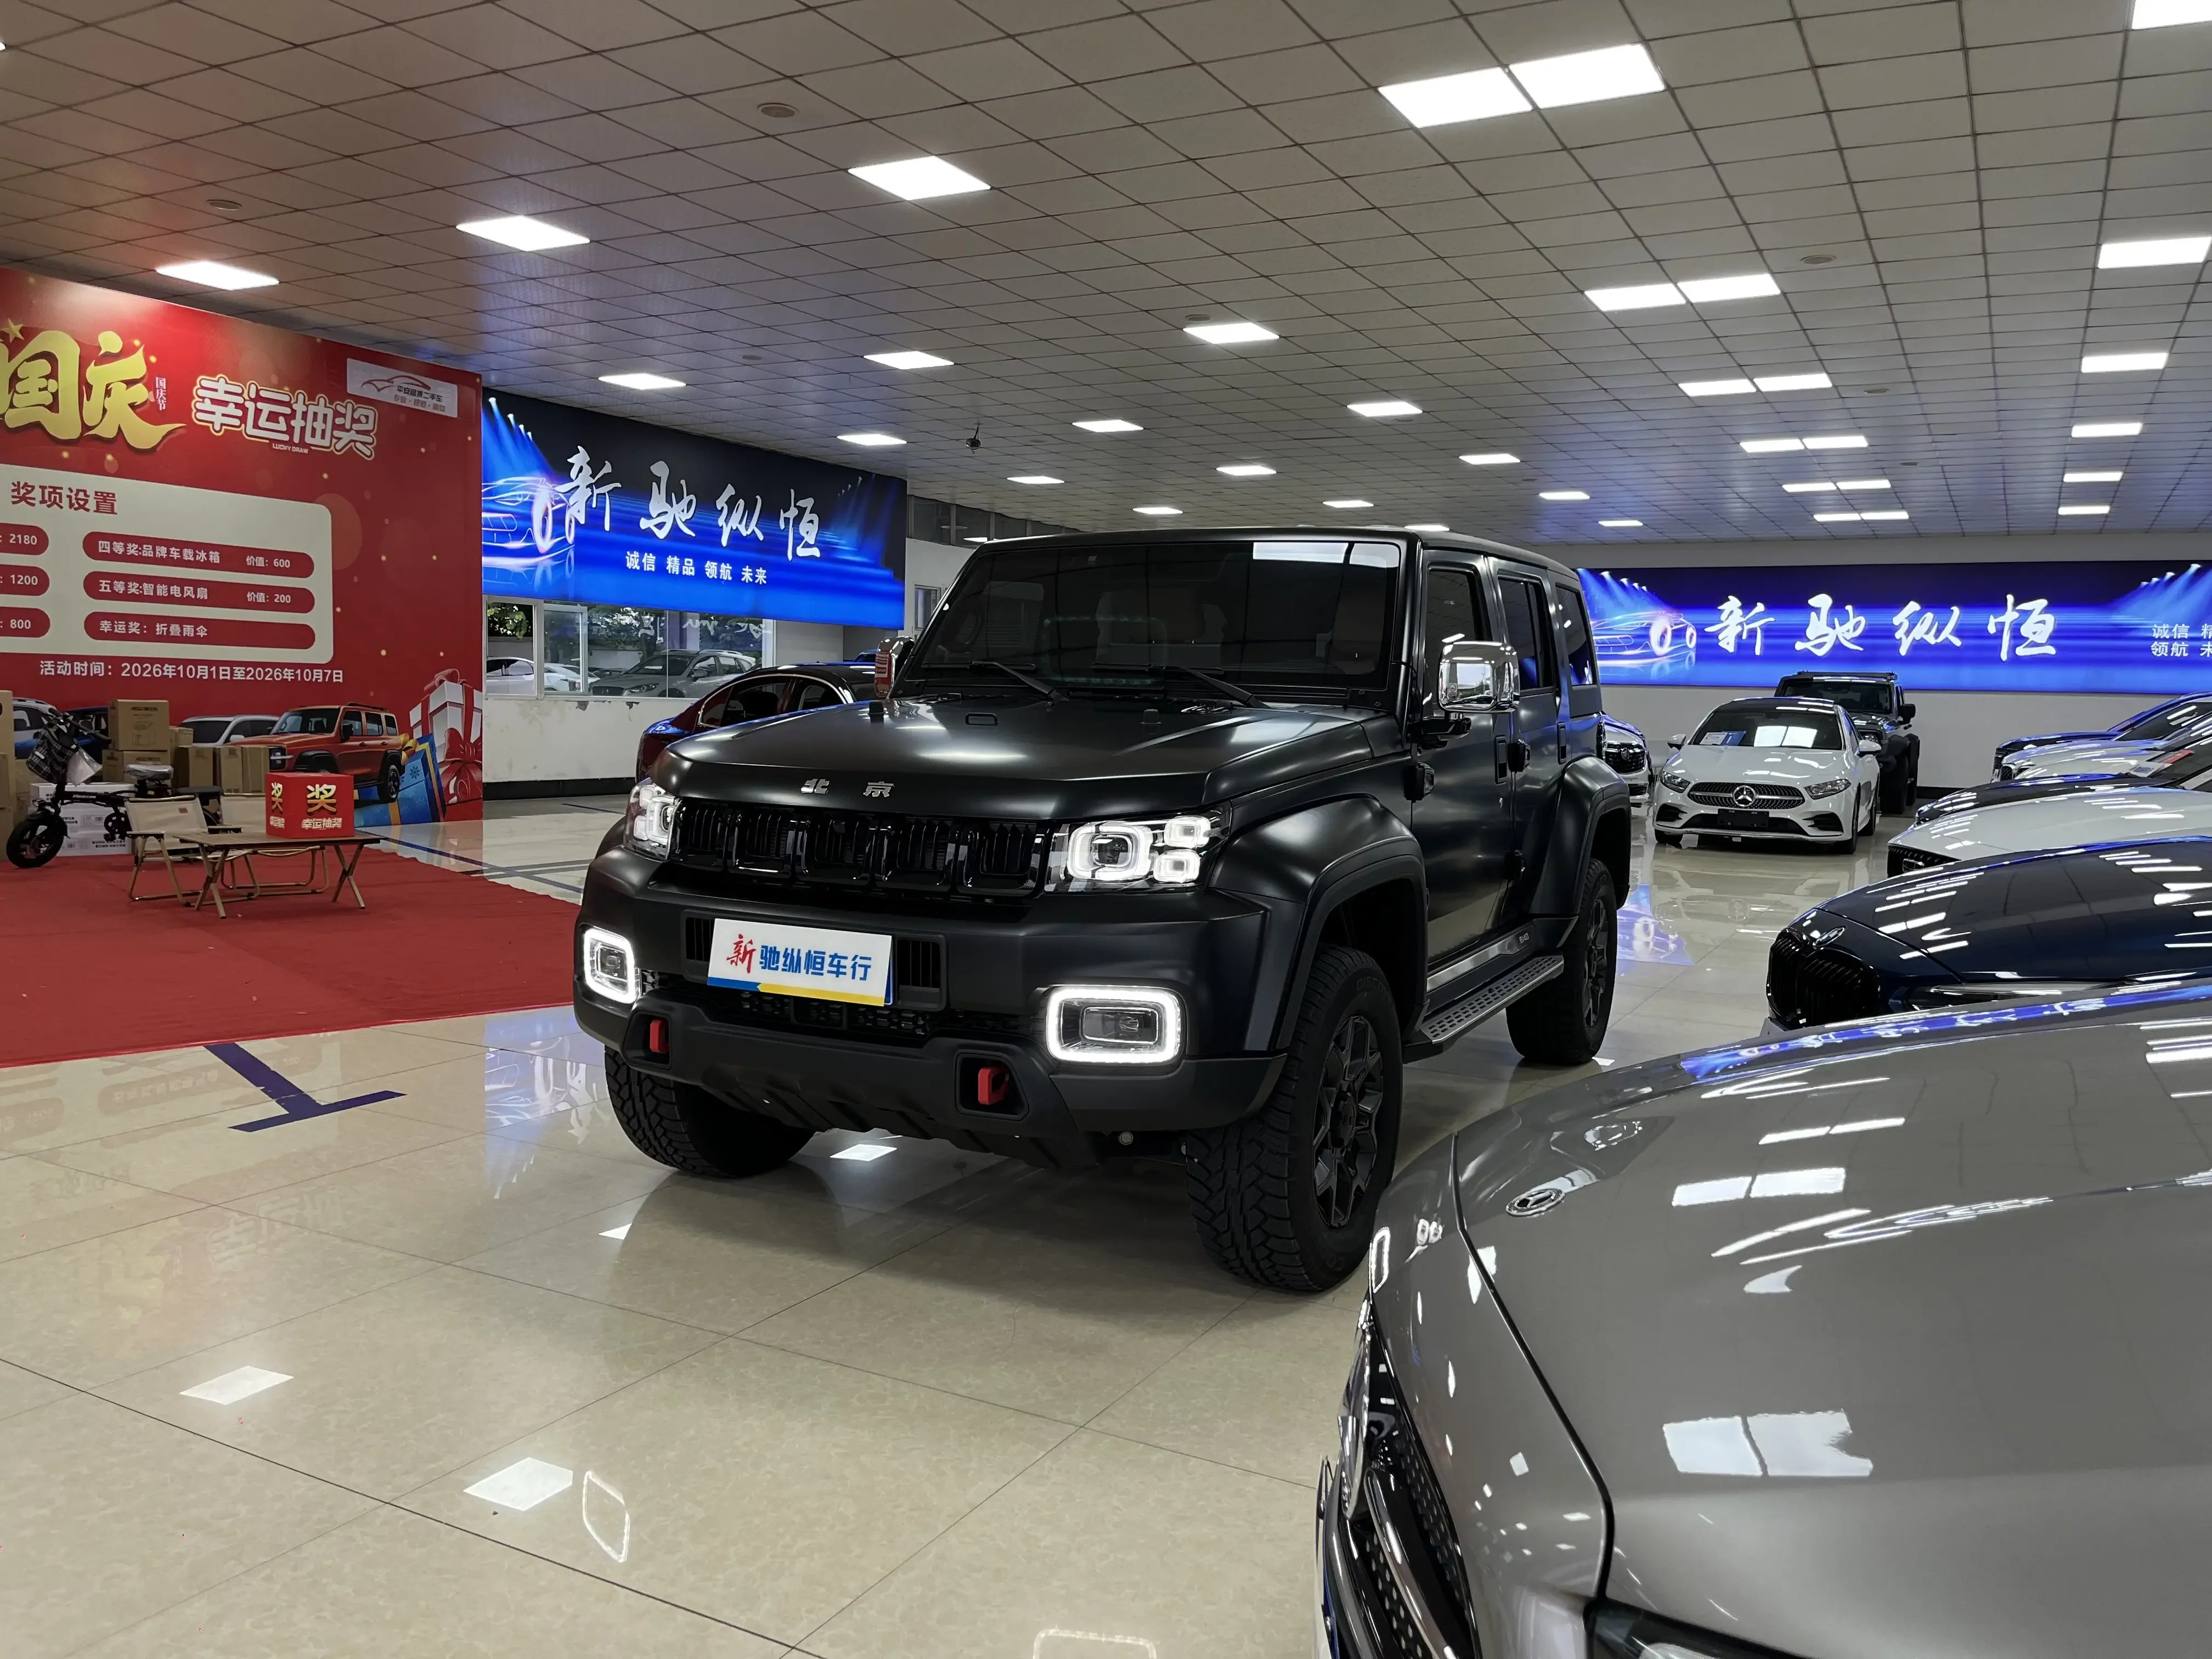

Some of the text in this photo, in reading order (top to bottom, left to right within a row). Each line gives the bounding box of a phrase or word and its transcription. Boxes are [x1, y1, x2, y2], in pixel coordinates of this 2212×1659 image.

[0, 330, 187, 449] 国庆
[155, 376, 167, 411] 国庆节
[193, 376, 376, 458] 幸运抽奖
[272, 443, 309, 454] LUCKY DRAW
[11, 481, 117, 515] 奖项设置
[625, 550, 767, 585] 诚信 精品 领航 未来
[2152, 623, 2190, 639] 诚信
[2151, 641, 2189, 657] 领航
[271, 782, 283, 812] 奖
[306, 783, 337, 813] 奖
[800, 778, 895, 797] 北京
[301, 817, 343, 829] 幸运抽奖
[1519, 932, 1530, 944] BJ40
[726, 934, 872, 981] 新驰纵恒车行
